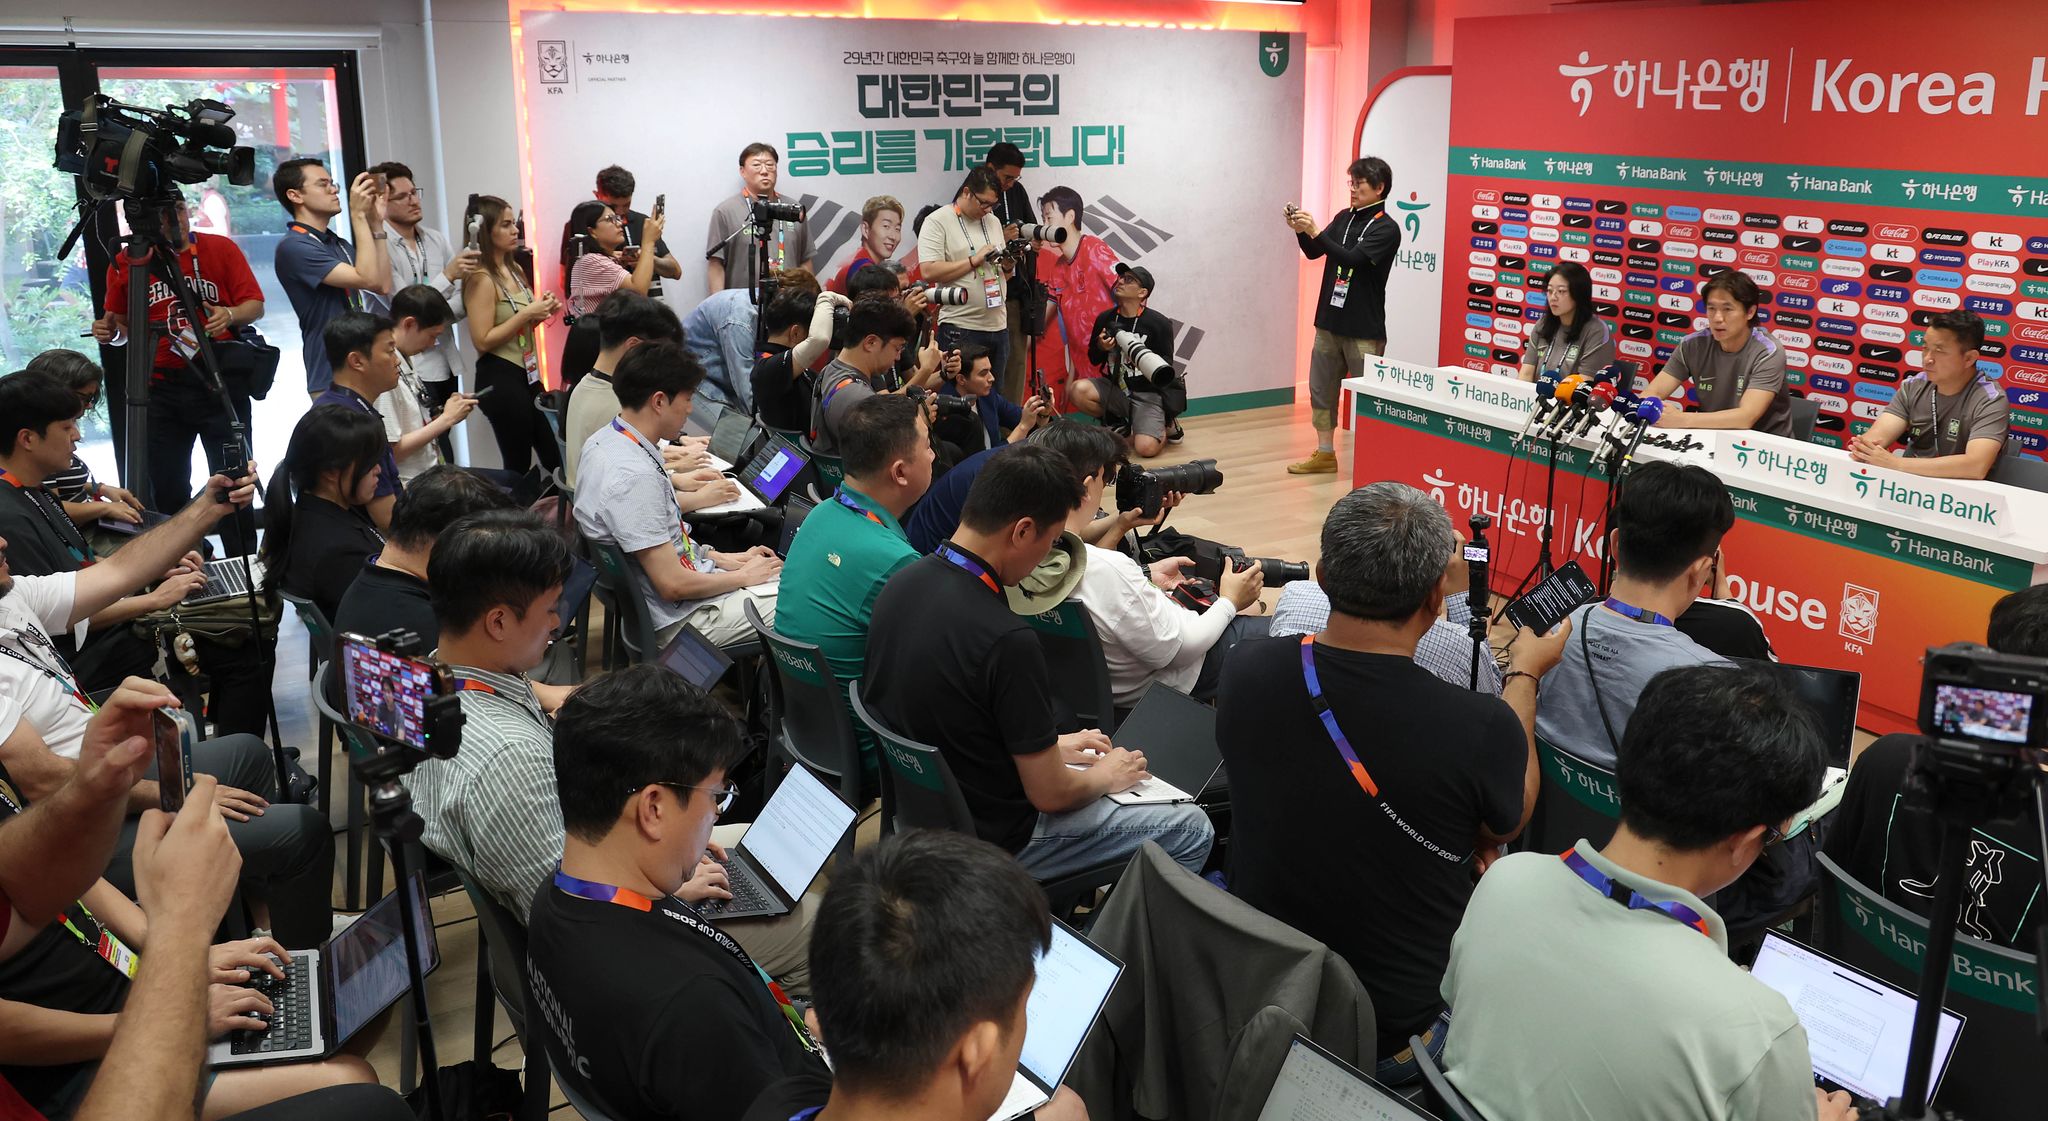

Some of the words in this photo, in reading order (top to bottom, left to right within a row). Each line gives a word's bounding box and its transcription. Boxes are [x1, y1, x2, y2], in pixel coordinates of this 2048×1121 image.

[596, 54, 630, 64] 하나은행
[843, 51, 884, 66] 29년간
[886, 51, 934, 66] 대한민국
[937, 51, 971, 65] 축구와
[973, 51, 984, 66] 늘
[987, 51, 1020, 65] 함께한
[1022, 51, 1075, 66] 하나은행이
[547, 87, 563, 95] KFA
[1613, 58, 1769, 113] 하나은행
[1810, 58, 1996, 116] Korea
[857, 73, 1060, 119] 대한민국의
[786, 129, 917, 177] 승리를
[923, 125, 1125, 172] 기원합니다!
[1482, 155, 1504, 169] Hana
[1505, 157, 1527, 171] Bank
[1557, 160, 1593, 176] 하나은행
[1632, 165, 1660, 180] Hana
[1661, 167, 1687, 182] Bank
[1720, 170, 1764, 187] 하나은행
[1805, 177, 1837, 192] Hana
[1838, 179, 1872, 195] Bank
[1922, 183, 1977, 202] 하나은행
[1542, 197, 1550, 206] kt
[2030, 190, 2048, 205] Ha
[1481, 208, 1489, 216] kt
[1600, 220, 1620, 229] 교보생명
[1640, 223, 1650, 233] kt
[1797, 219, 1809, 230] kt
[1754, 234, 1765, 244] kt
[1989, 236, 2004, 248] kt
[1570, 250, 1578, 259] kt
[1713, 249, 1722, 259] kt
[1886, 247, 1899, 259] kt
[1934, 254, 1961, 263] HYUNDAI
[1792, 258, 1813, 268] 하나은행
[1506, 290, 1514, 299] kt
[1600, 288, 1608, 297] kt
[1874, 288, 1902, 299] 교보생명
[1670, 298, 1680, 308] kt
[1783, 296, 1808, 306] 교보생명
[1832, 302, 1844, 313] kt
[1972, 300, 2003, 311] 교보생명
[2034, 306, 2048, 318] kt
[1474, 331, 1482, 340] kt
[1390, 366, 1434, 392] 하나은행
[1500, 367, 1508, 377] kt
[1816, 378, 1843, 389] 교보생명
[1465, 383, 1499, 406] Hana
[1501, 391, 1534, 413] Bank
[1385, 404, 1407, 420] Hana
[1407, 409, 1428, 425] Bank
[1866, 406, 1878, 417] kt
[2017, 414, 2043, 426] 하나은행
[1457, 422, 1492, 442] 하나은행
[1522, 440, 1548, 457] Hana
[1548, 448, 1575, 464] ank
[1759, 448, 1828, 485] 하나은행
[1879, 479, 1936, 511] Hana
[1940, 493, 1998, 526] Bank
[1458, 483, 1555, 544] 하나은행
[1804, 511, 1857, 540] 하나은행
[1908, 540, 1951, 564] Hana
[1953, 551, 1995, 575] Bank
[1726, 574, 1827, 630] ouse
[7, 650, 23, 659] CUP
[1844, 641, 1864, 656] KFA
[785, 652, 816, 673] Bank
[1576, 772, 1622, 806] 하나
[0, 793, 14, 807] CUP
[1380, 802, 1397, 820] FIFA
[1396, 818, 1425, 843] WORLD
[1423, 840, 1440, 852] CUP
[1437, 849, 1461, 862] 2026
[698, 924, 715, 937] CUP
[715, 932, 740, 953] WORLD
[737, 953, 753, 968] FIFA
[1878, 916, 1927, 955] Han
[1952, 953, 2035, 996] Bank
[526, 950, 576, 1046] NATIONAL
